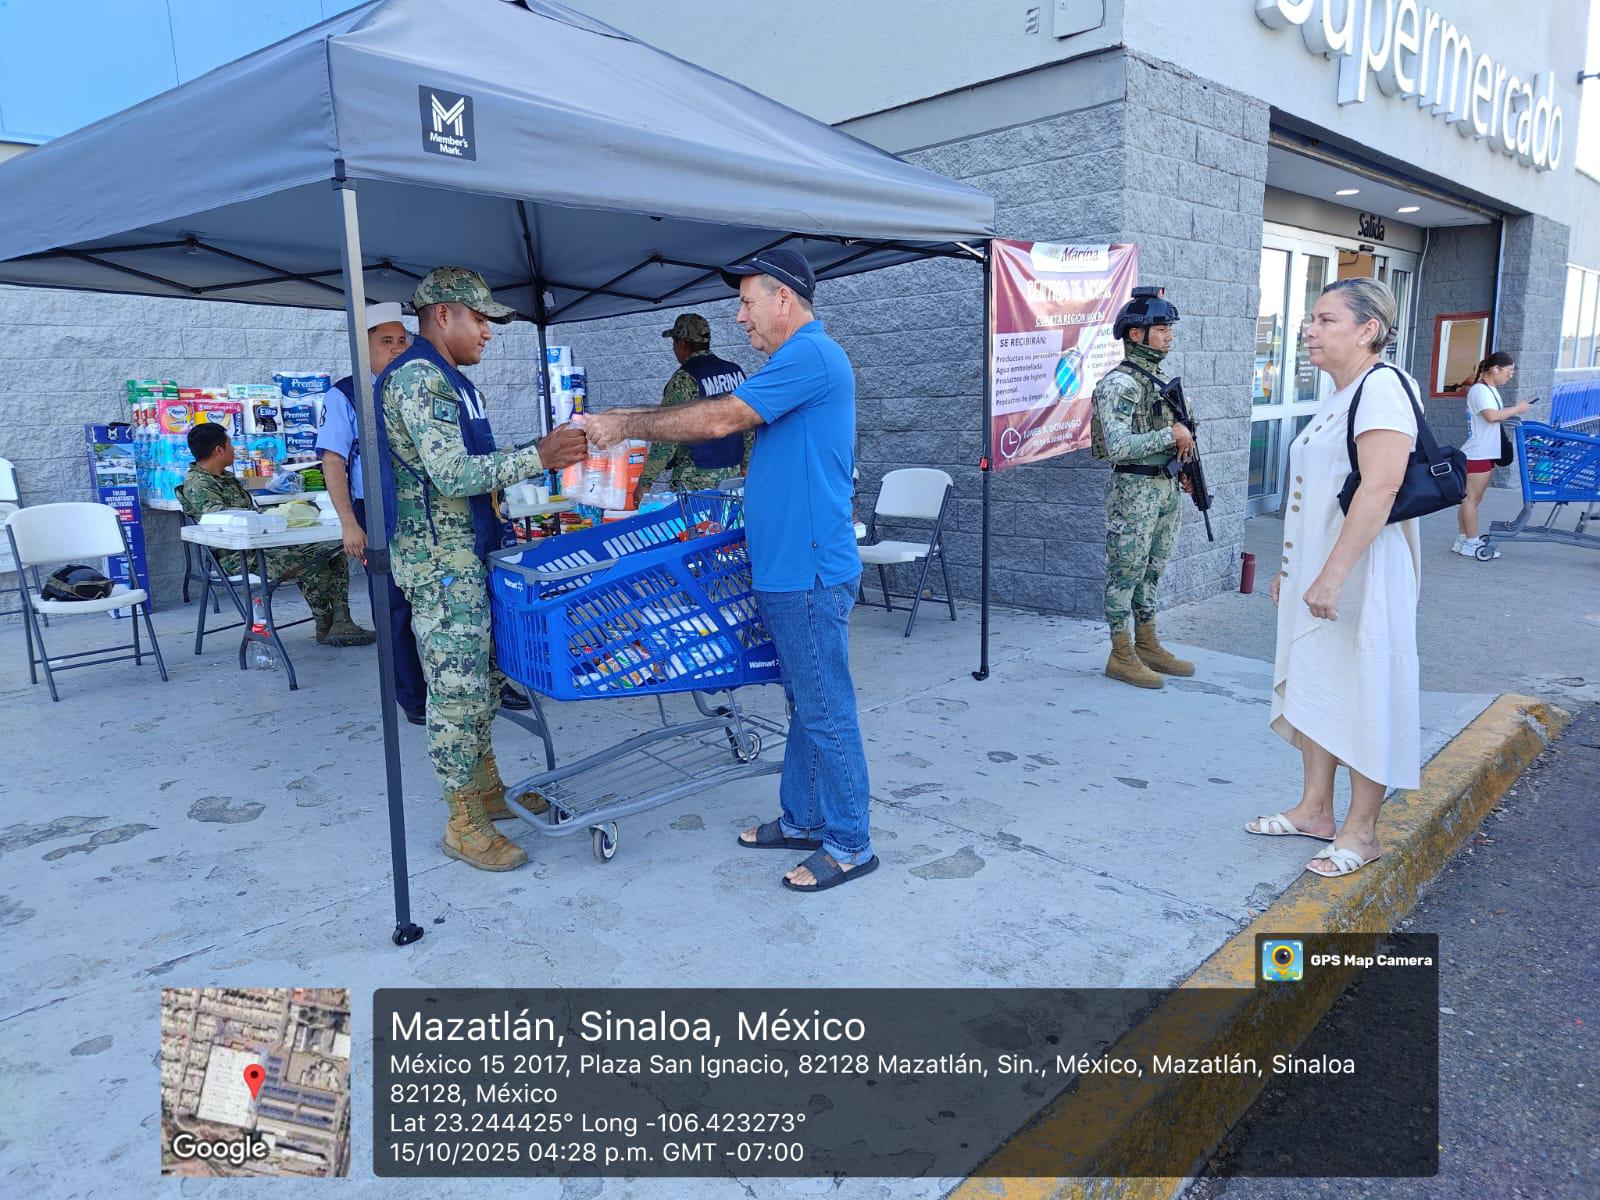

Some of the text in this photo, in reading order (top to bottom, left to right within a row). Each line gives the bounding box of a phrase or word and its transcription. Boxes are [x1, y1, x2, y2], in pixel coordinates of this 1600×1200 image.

[1270, 0, 1564, 172] upermercado
[430, 131, 469, 148] Member's
[1358, 212, 1385, 241] Salida
[1060, 246, 1100, 263] Marina
[1000, 335, 1047, 348] SE RECIBIRÁN:
[996, 355, 1024, 364] Productos
[996, 367, 1010, 376] Agua
[292, 379, 324, 389] Premier
[701, 371, 745, 397] MARINA
[996, 376, 1022, 385] Productos
[1023, 374, 1030, 382] de
[996, 396, 1021, 406] Productos
[284, 411, 310, 420] Premier
[1048, 418, 1082, 433] DOMINGO
[287, 436, 314, 446] Premier
[749, 659, 775, 669] Walmart
